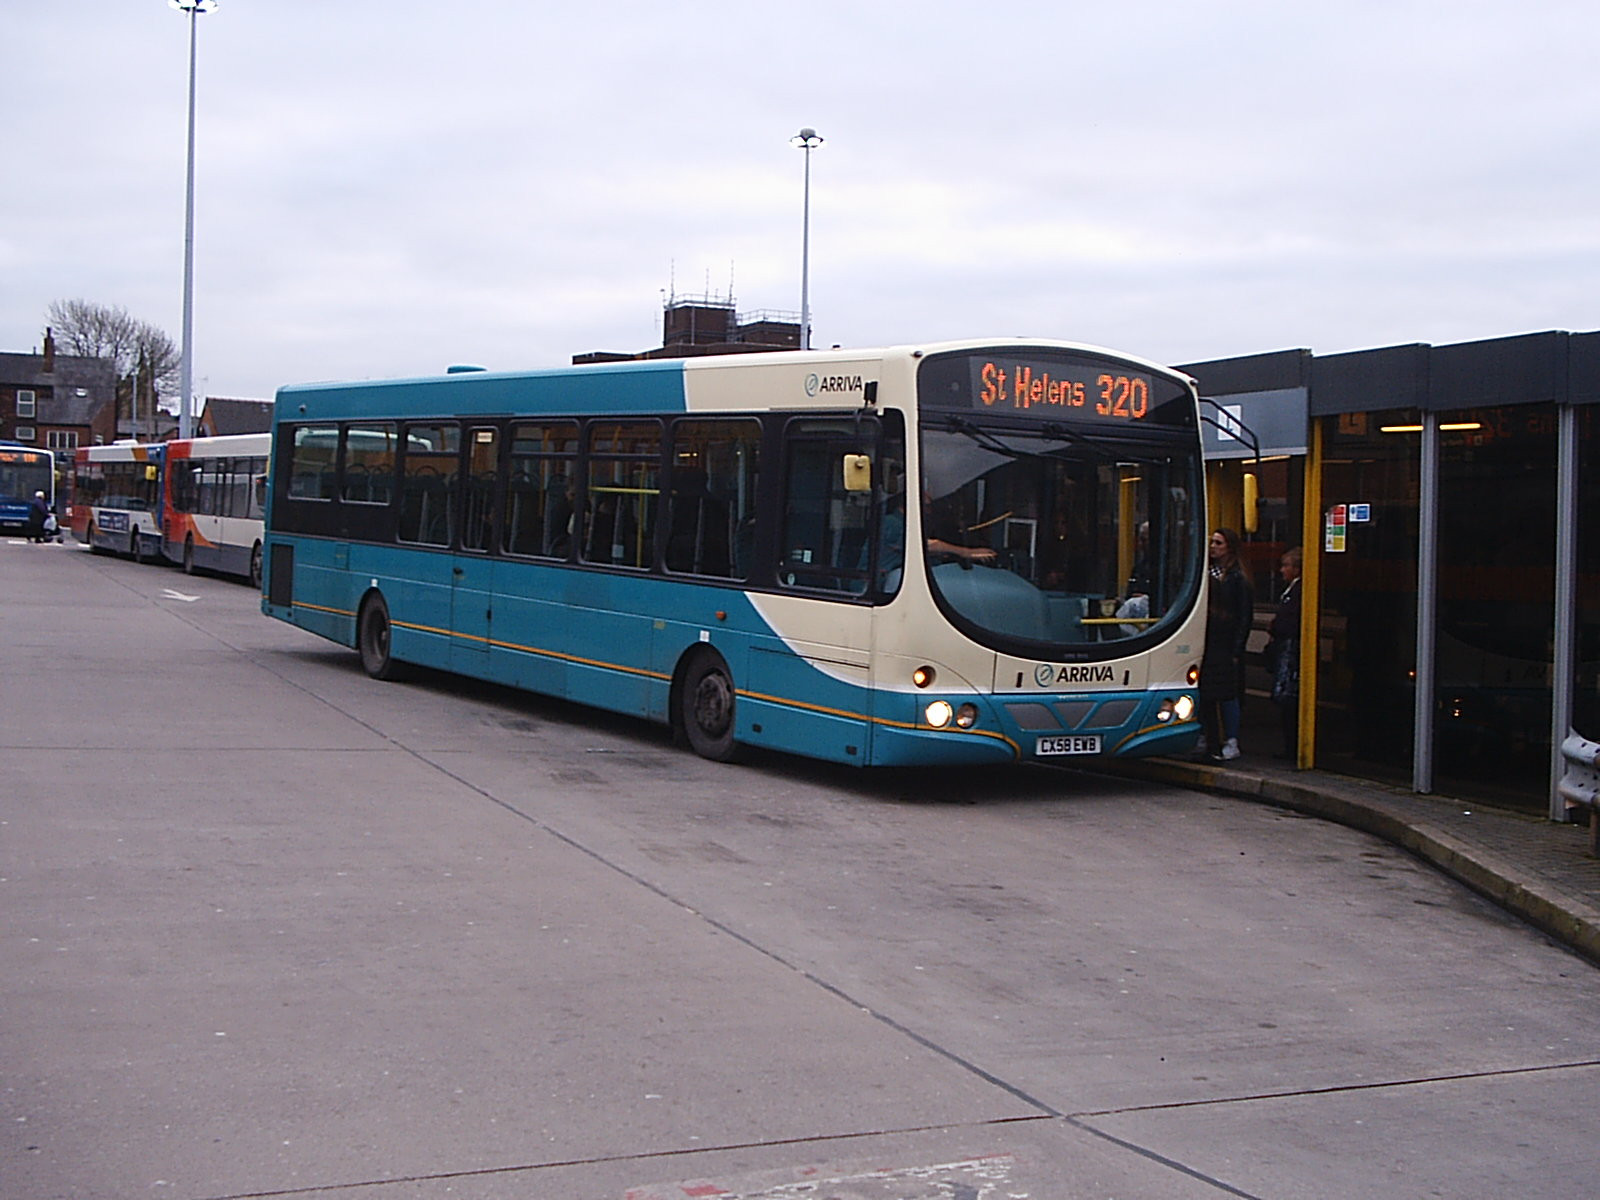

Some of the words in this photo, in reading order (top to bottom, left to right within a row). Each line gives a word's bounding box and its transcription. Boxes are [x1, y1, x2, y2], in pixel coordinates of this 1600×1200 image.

[820, 375, 863, 392] ARRIVA
[980, 362, 1007, 406] St
[1014, 365, 1086, 409] Helens
[1095, 374, 1148, 419] 320
[1056, 666, 1114, 683] ARRIVA
[1041, 738, 1071, 753] CX58
[1073, 737, 1096, 752] EWB
